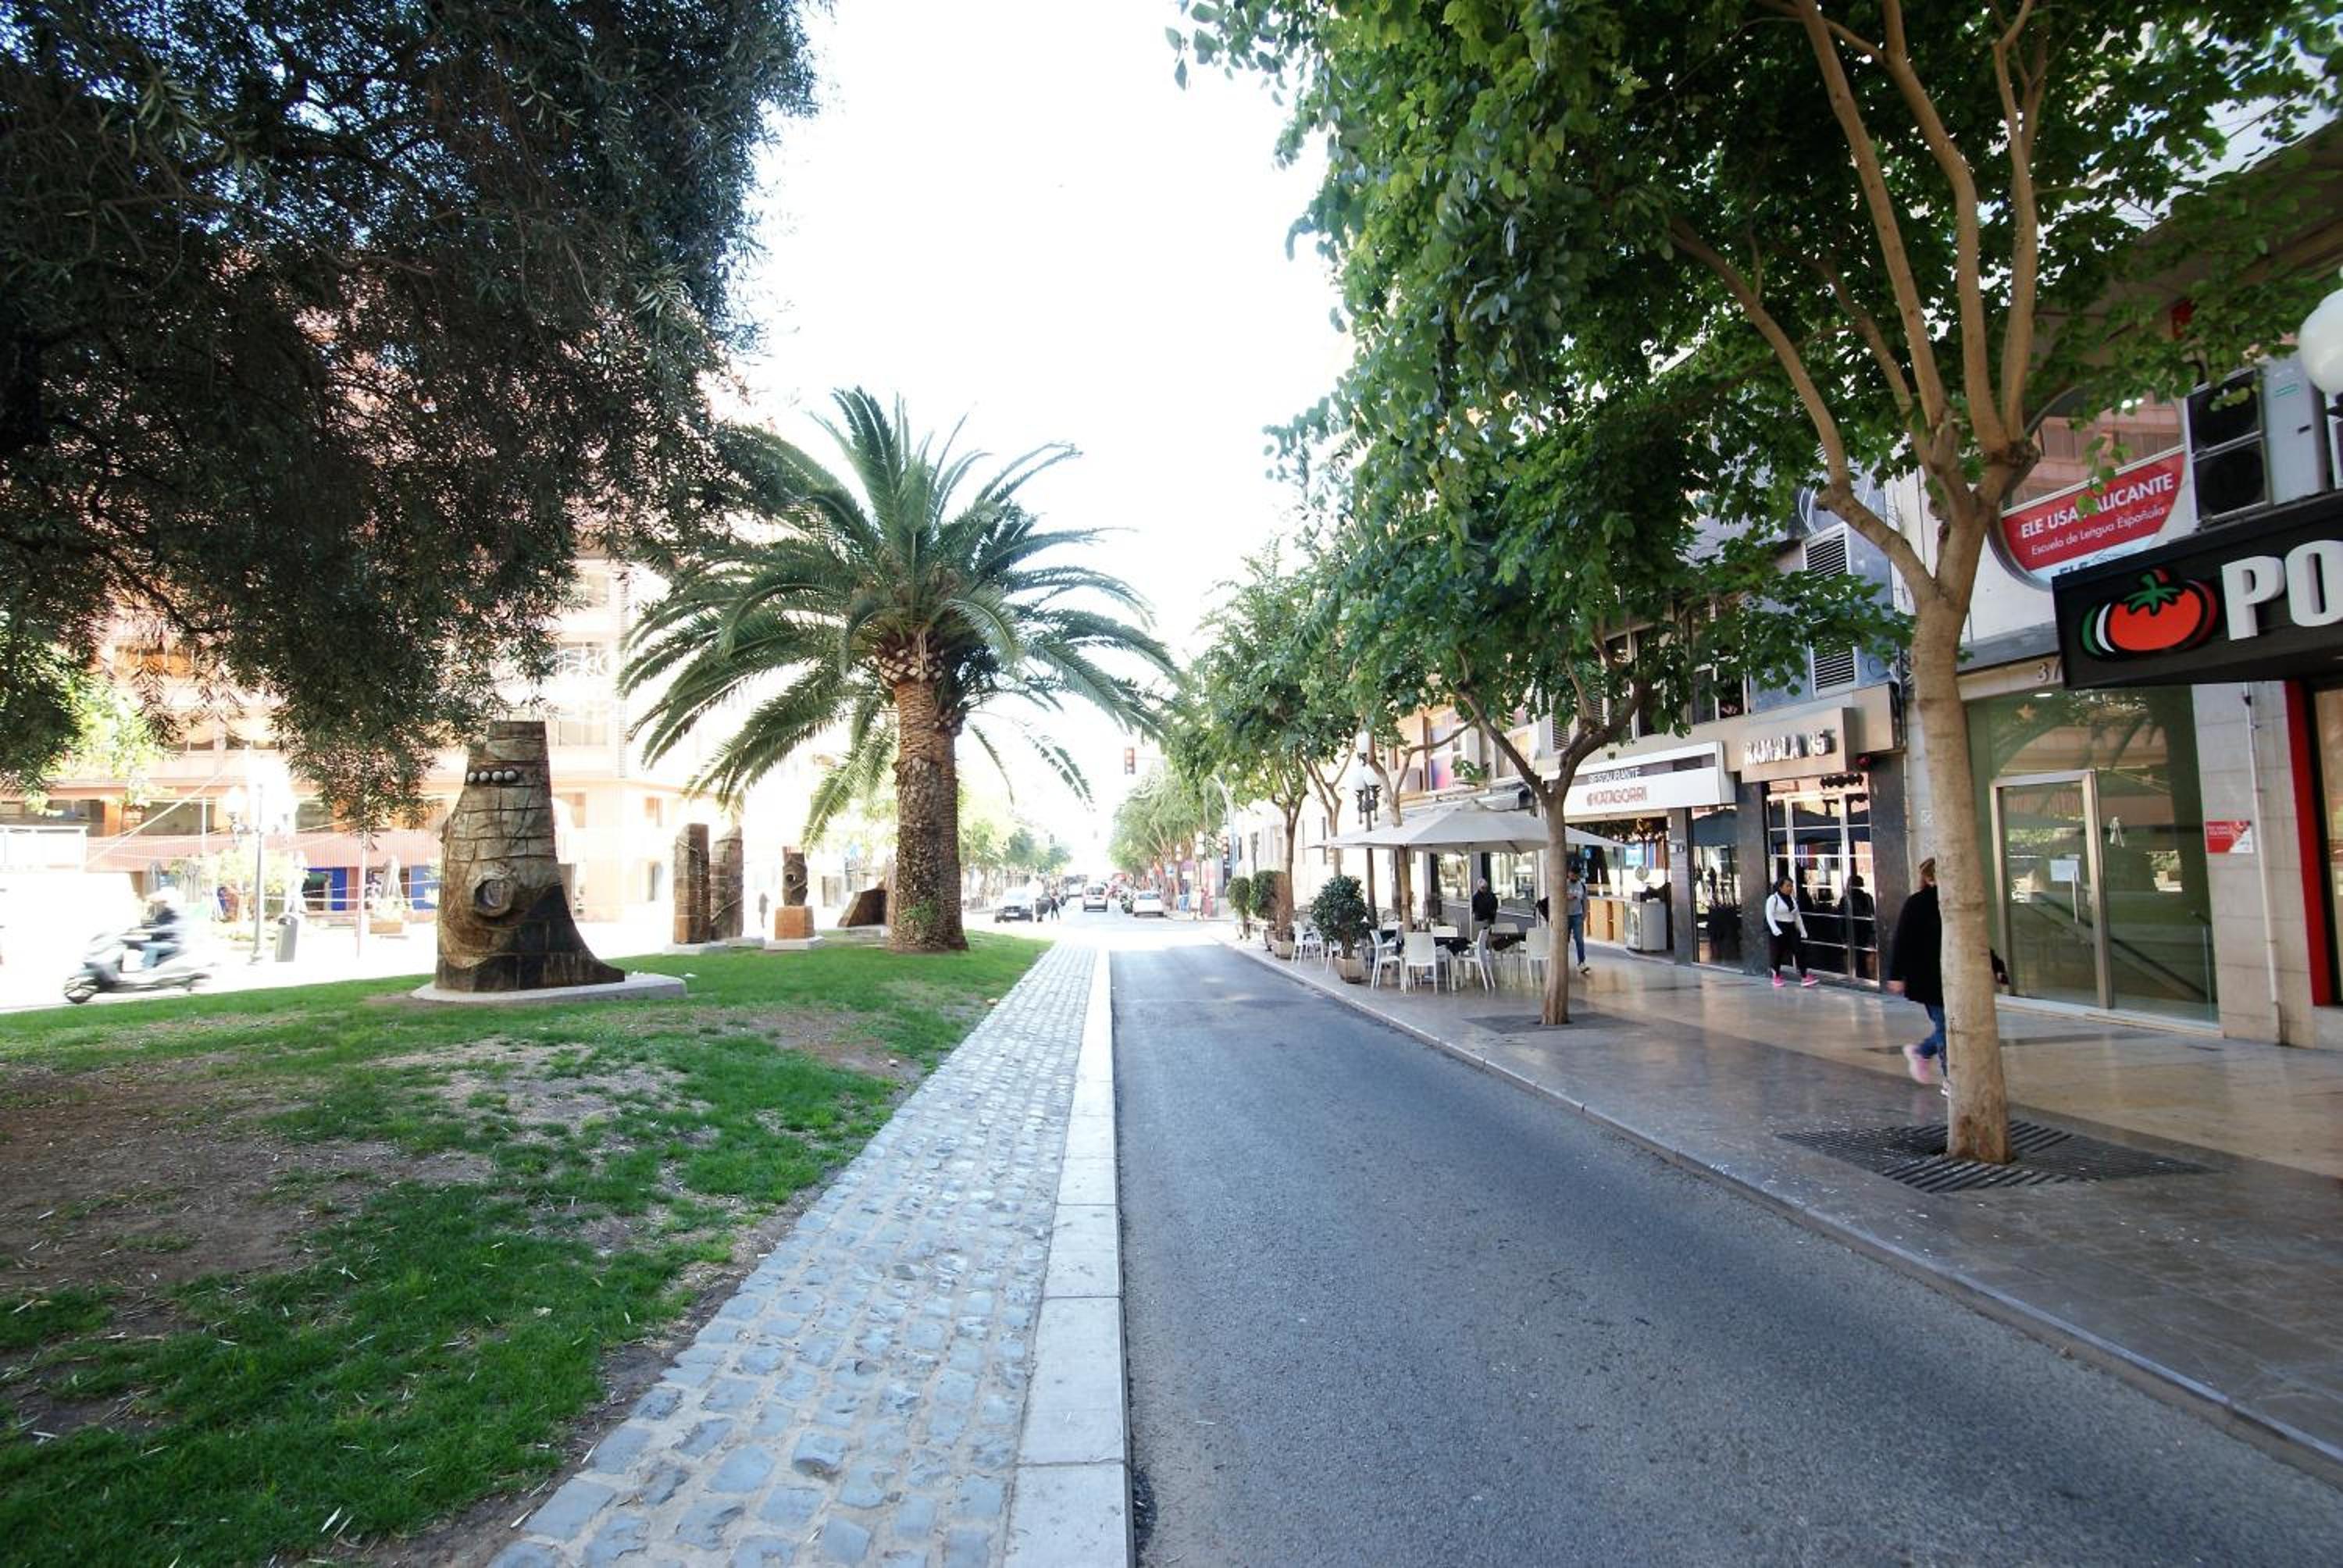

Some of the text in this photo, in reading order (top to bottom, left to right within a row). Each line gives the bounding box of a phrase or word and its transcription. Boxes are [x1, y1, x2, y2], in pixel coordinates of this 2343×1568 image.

[2020, 518, 2044, 539] ELE
[2047, 505, 2088, 529] USA
[2031, 504, 2165, 556] Escuela de Lengua Española
[2221, 540, 2343, 641] PO
